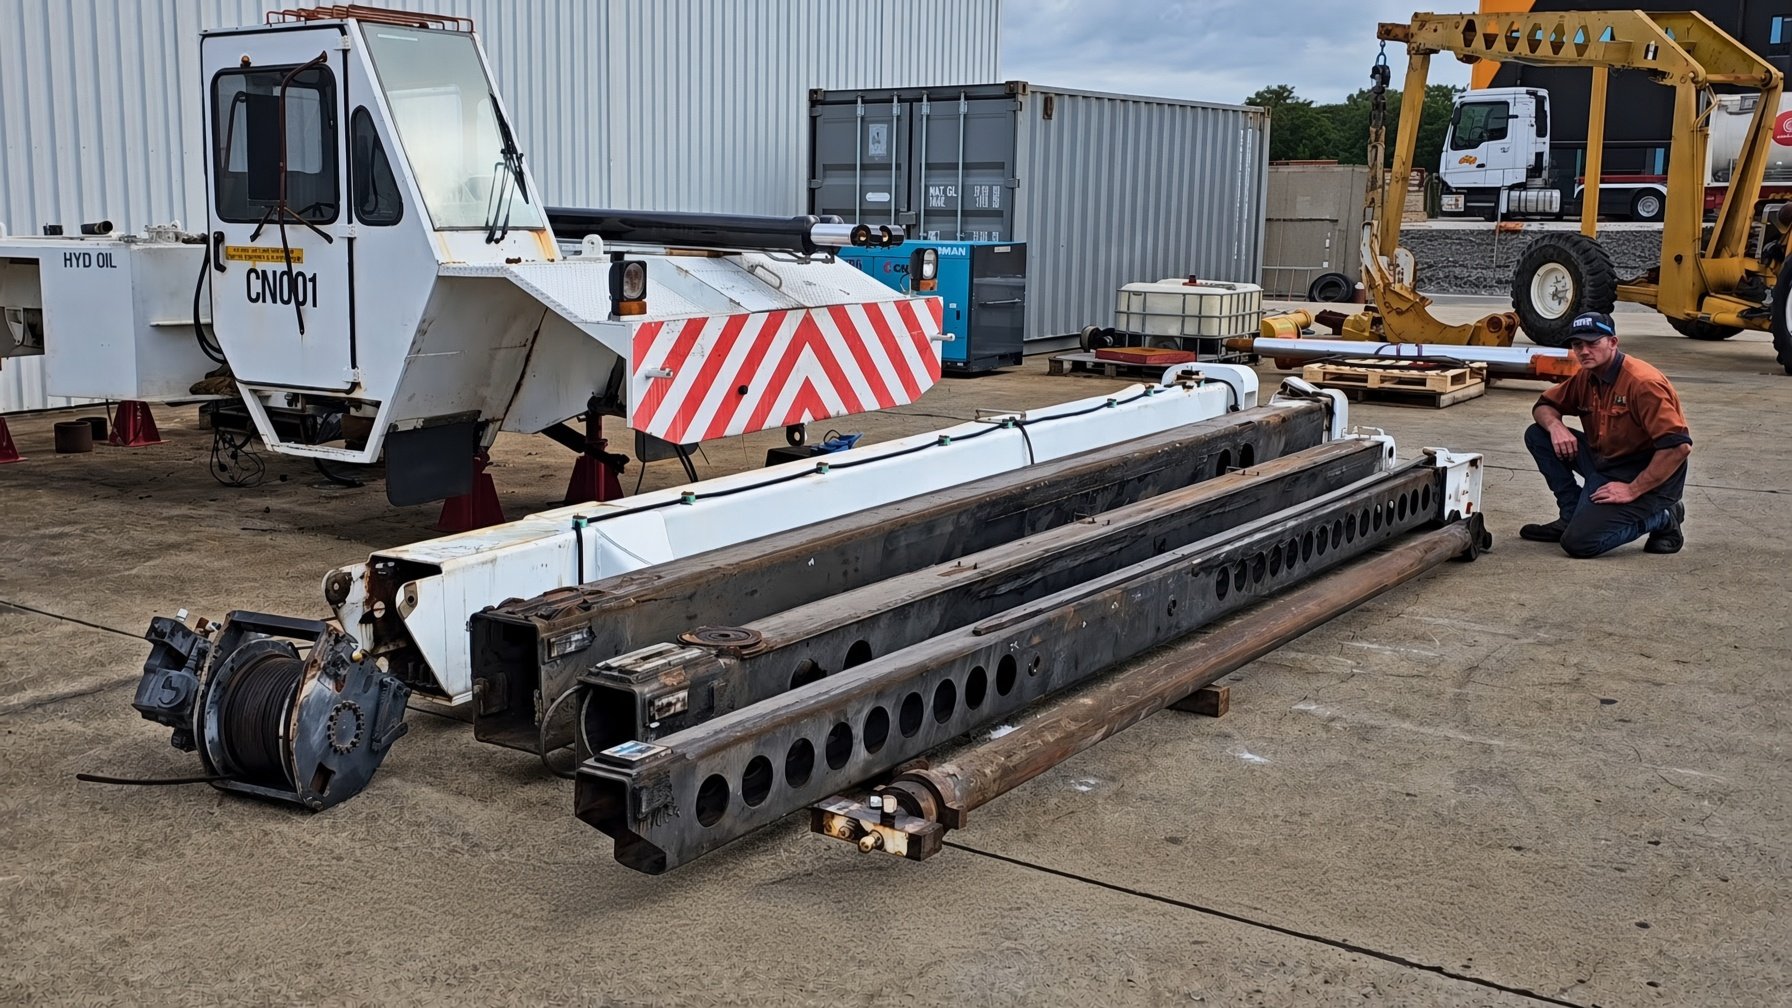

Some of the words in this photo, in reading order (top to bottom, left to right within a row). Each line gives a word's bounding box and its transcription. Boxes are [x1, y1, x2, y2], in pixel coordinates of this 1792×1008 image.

[63, 251, 92, 268] HYD
[96, 251, 117, 269] OIL
[246, 267, 318, 308] CN001
